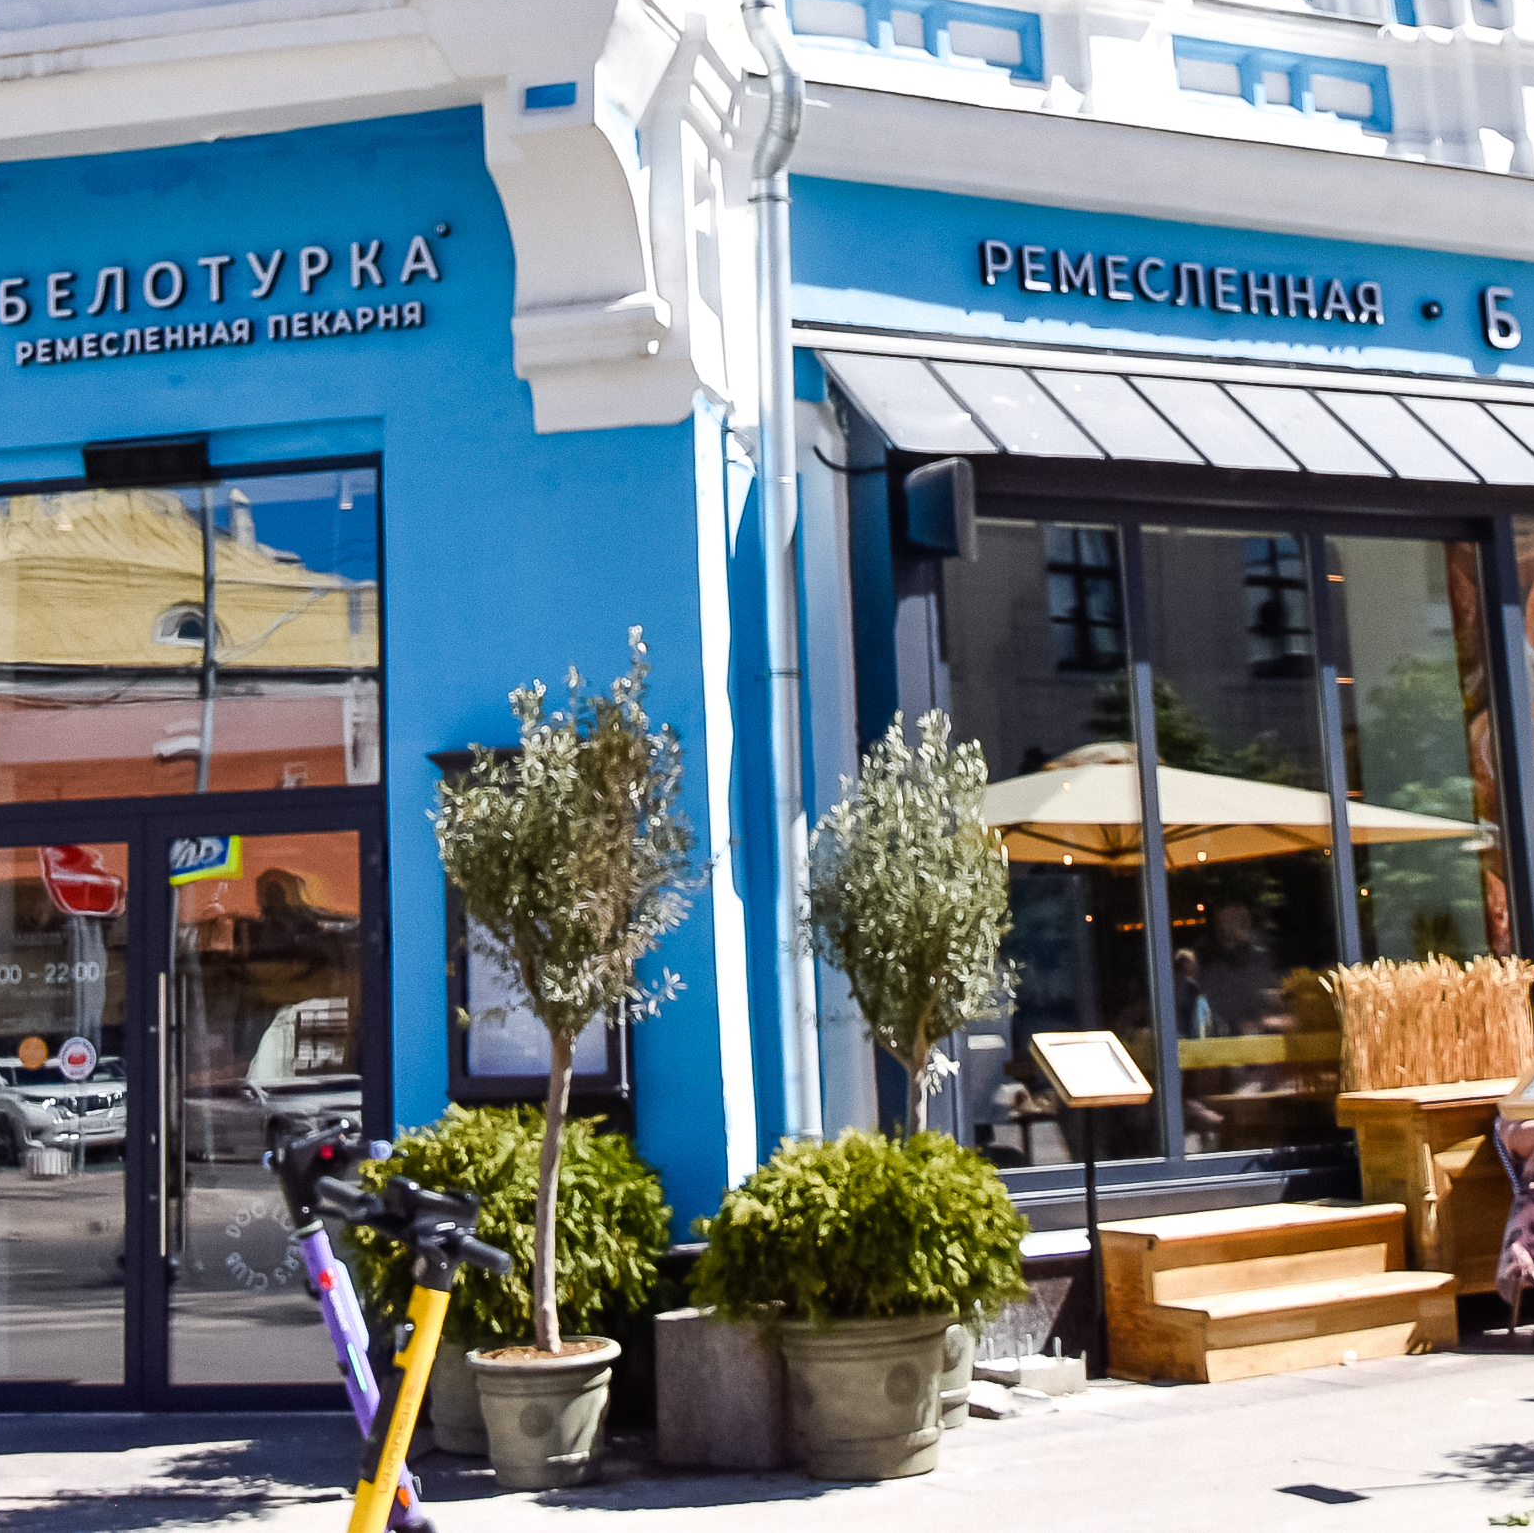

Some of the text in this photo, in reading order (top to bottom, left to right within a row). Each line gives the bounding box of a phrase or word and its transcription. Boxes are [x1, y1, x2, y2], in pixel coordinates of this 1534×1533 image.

[984, 239, 1385, 326] РЕМЕСЛЕННАЯ
[15, 300, 424, 366] РЕМЕСЛЕННАЯ ПЕКАРНЯ
